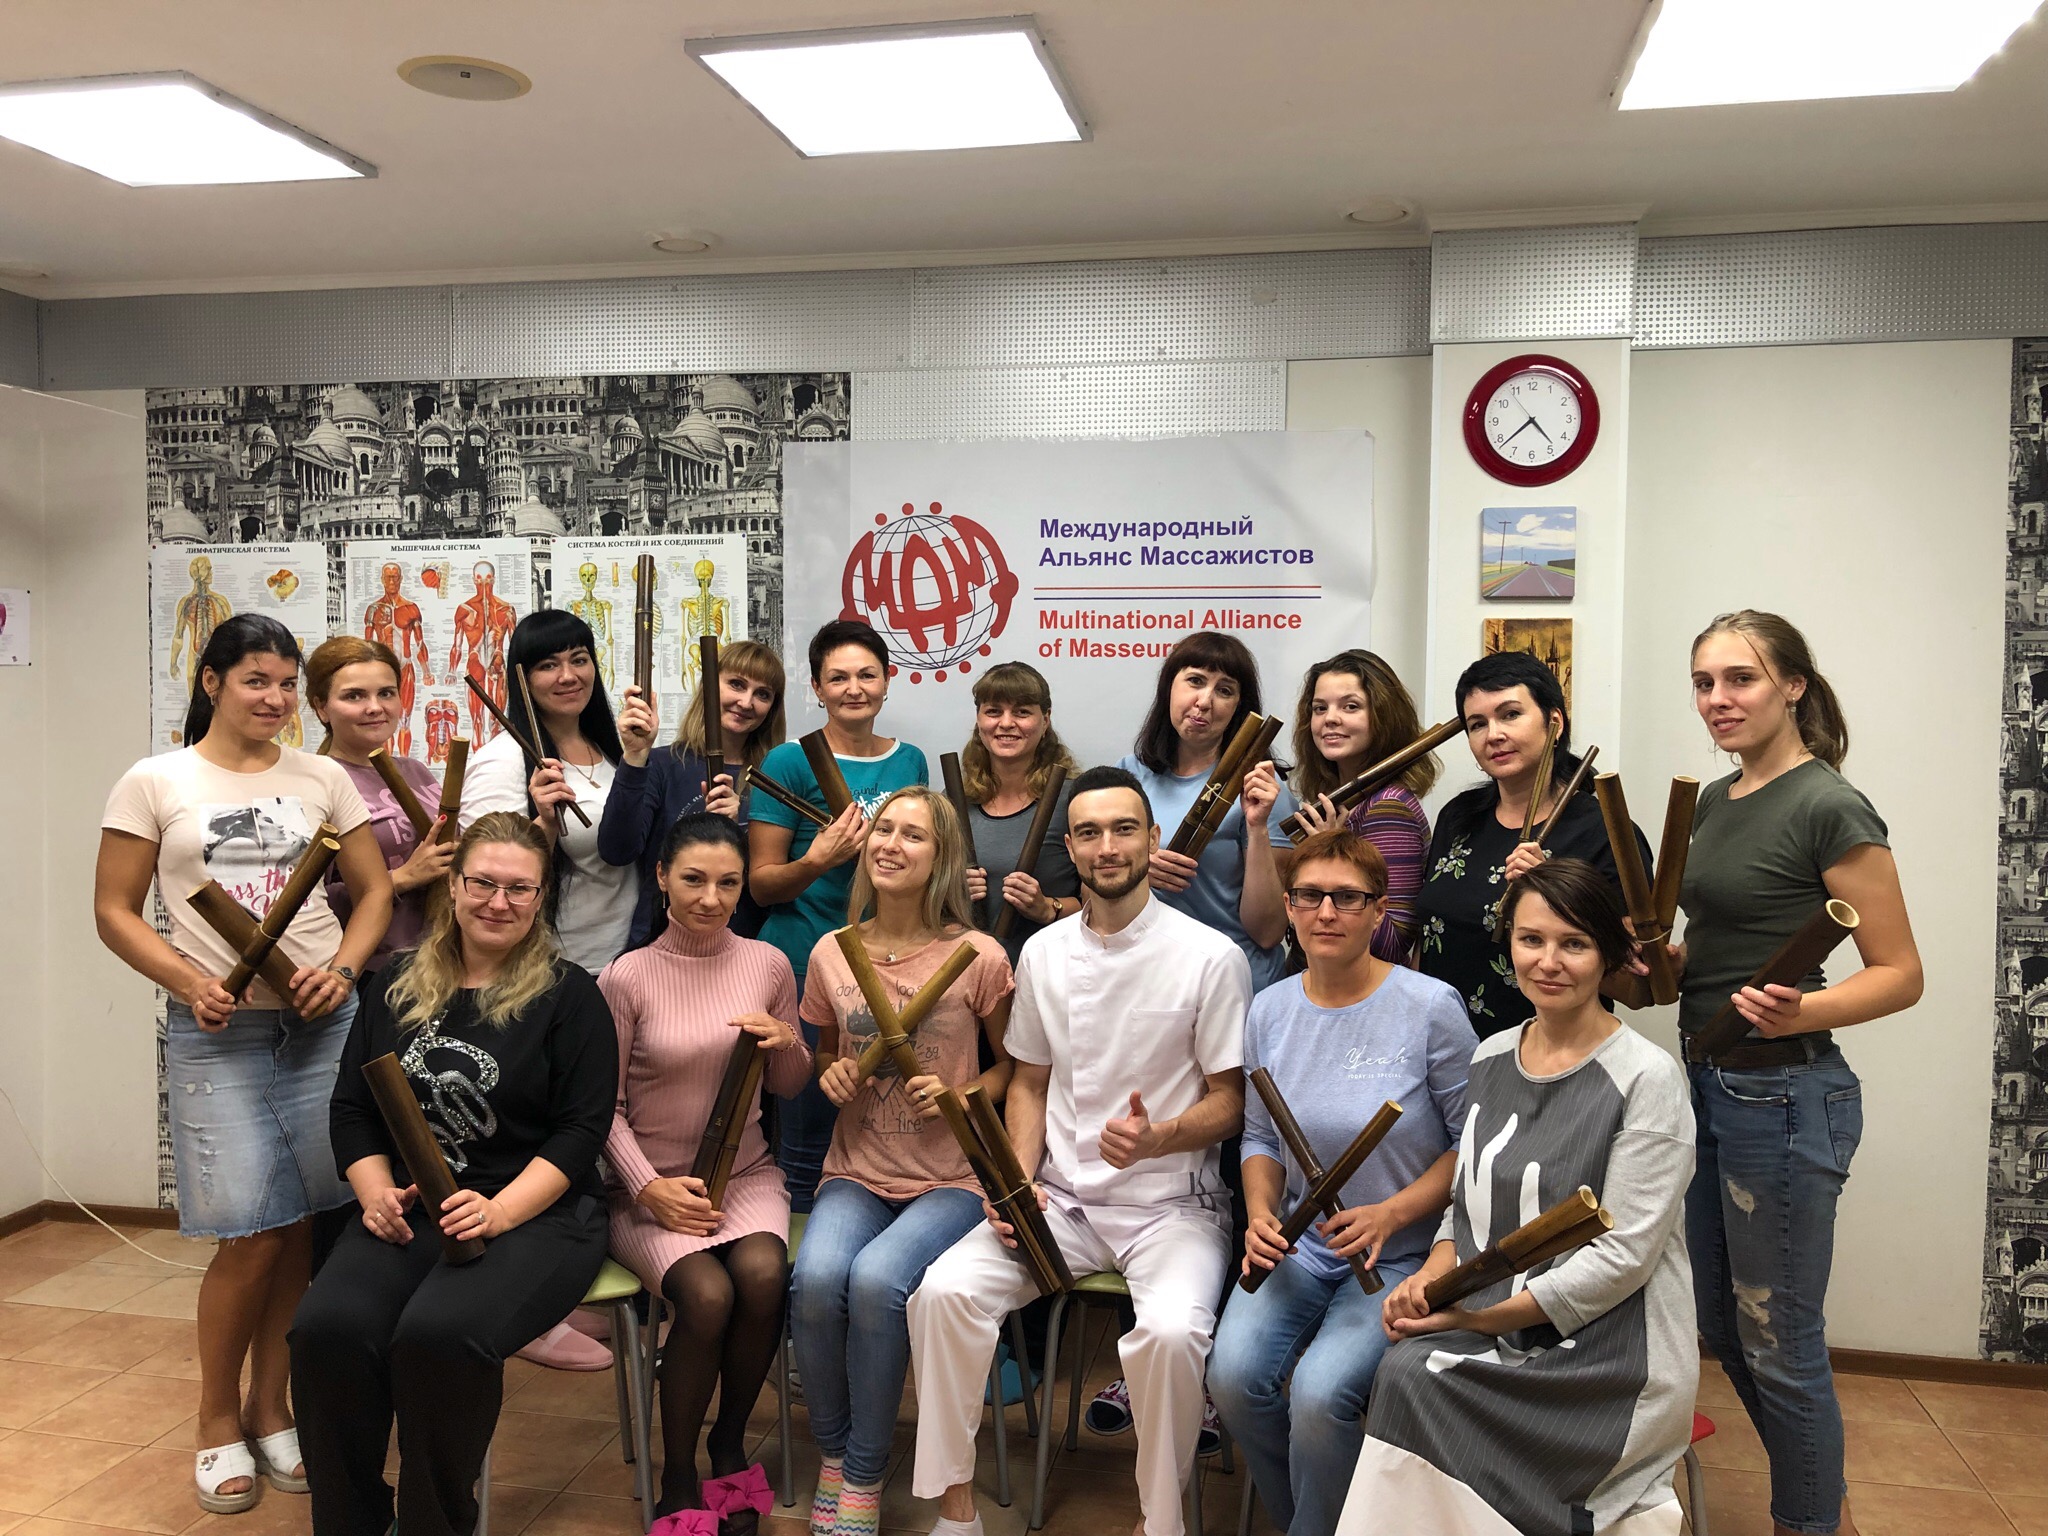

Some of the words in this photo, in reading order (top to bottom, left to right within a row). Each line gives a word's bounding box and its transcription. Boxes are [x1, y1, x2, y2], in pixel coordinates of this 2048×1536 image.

[1511, 386, 1520, 396] 11
[1527, 381, 1538, 391] 12
[1548, 385, 1552, 394] 1
[1498, 399, 1509, 409] 10
[1561, 397, 1567, 406] 2
[1492, 417, 1499, 426] 9
[1566, 414, 1573, 424] 3
[1497, 433, 1504, 443] 8
[1560, 431, 1567, 440] 4
[1511, 446, 1518, 456] 7
[1528, 450, 1535, 459] 6
[1547, 445, 1553, 454] 5
[1039, 514, 1253, 542] Международный
[391, 544, 441, 552] МЫШЕЧНАЯ
[567, 540, 607, 549] СИСТЕМА
[608, 539, 641, 548] КОСТЕЙ
[651, 539, 663, 547] ИХ
[665, 537, 724, 547] СОЕДИНЕНИЙ
[186, 546, 251, 554] ЛИМФАТИЧЕСКАЯ
[1039, 547, 1132, 567] Альянс
[1140, 546, 1314, 566] Массажистов
[1039, 610, 1193, 629] Multinational
[1201, 609, 1302, 629] Alliance
[1038, 638, 1062, 658] of
[1342, 1044, 1408, 1070] Yeah
